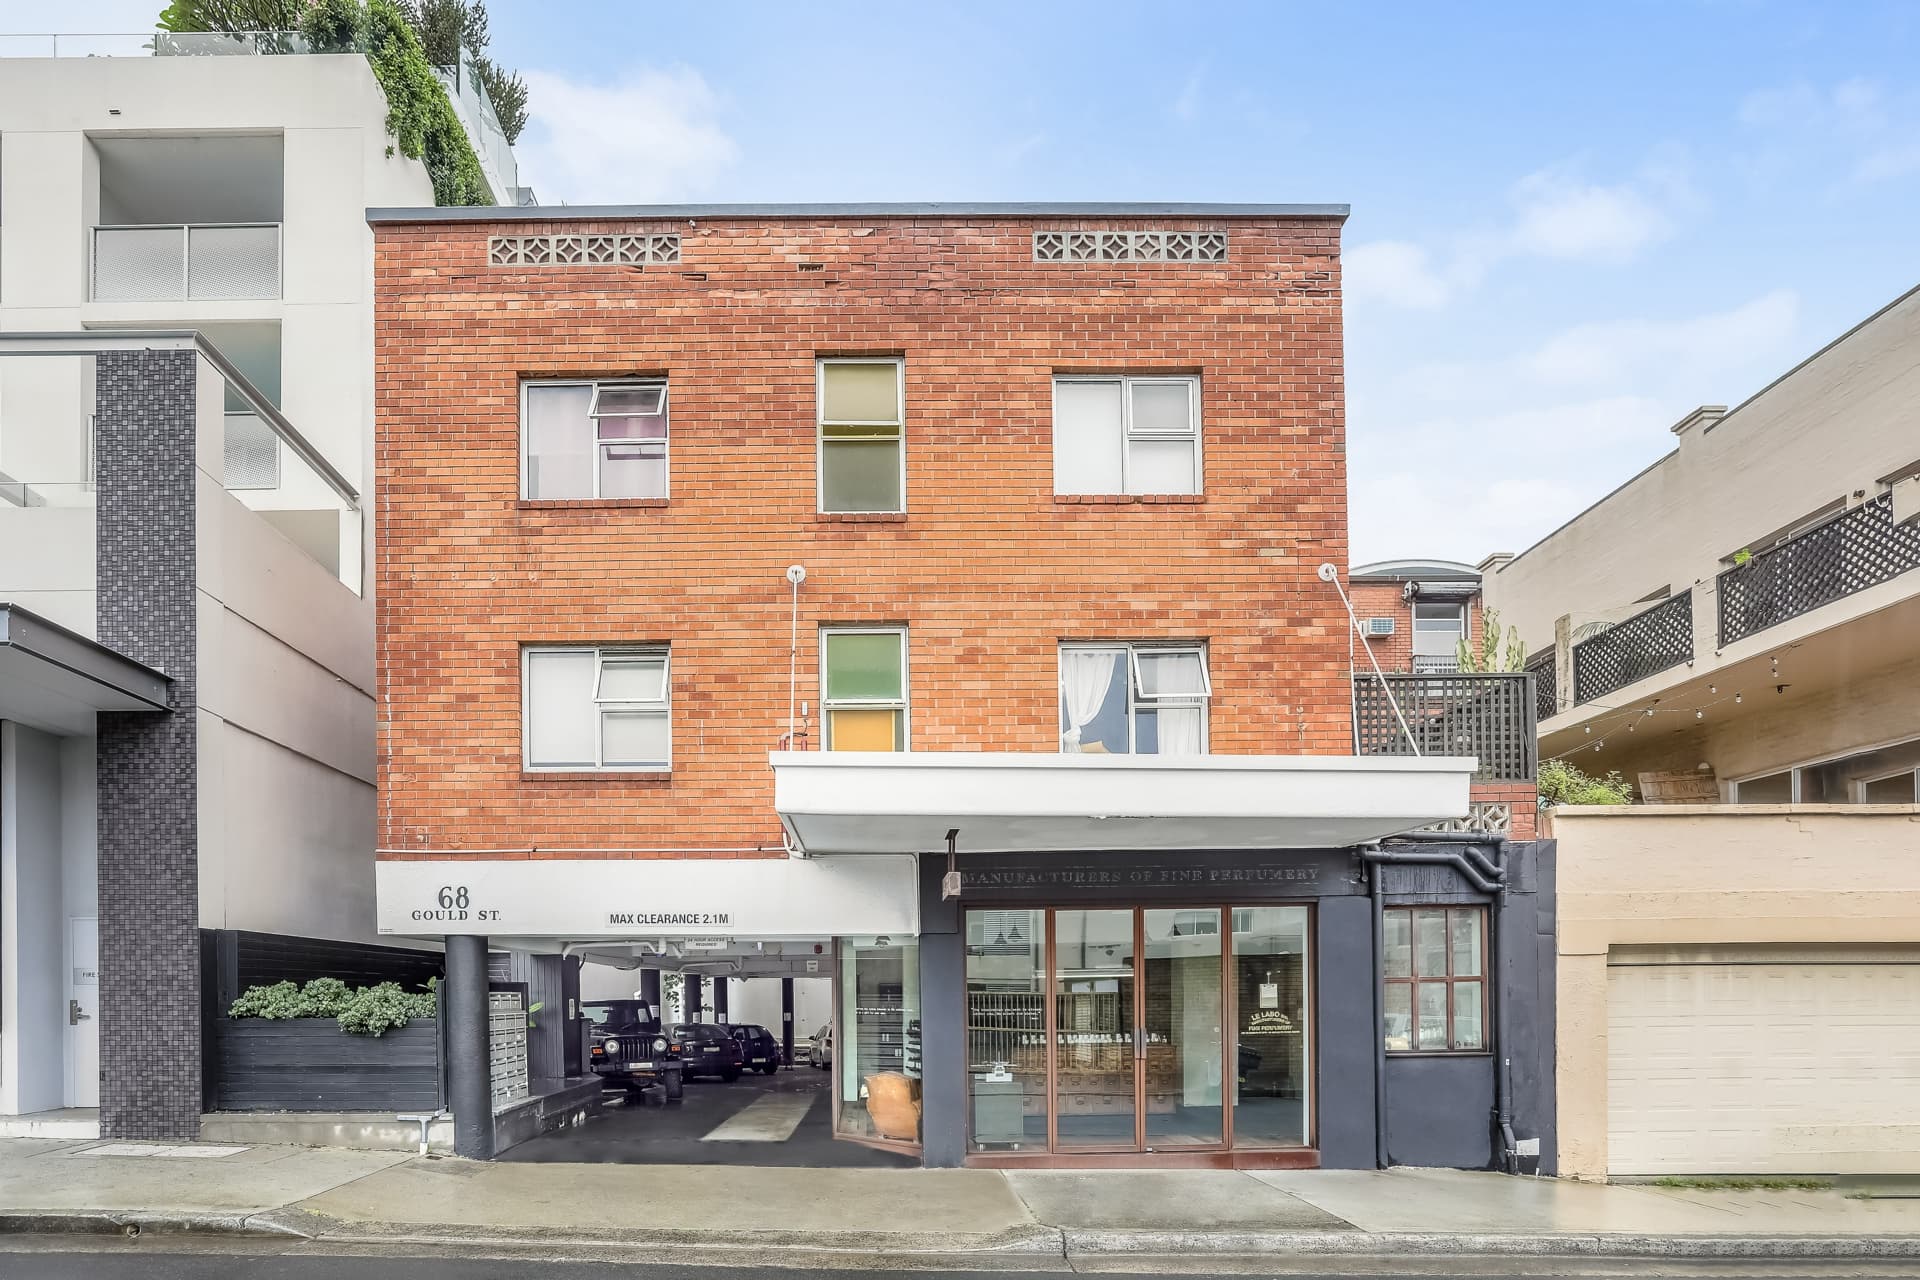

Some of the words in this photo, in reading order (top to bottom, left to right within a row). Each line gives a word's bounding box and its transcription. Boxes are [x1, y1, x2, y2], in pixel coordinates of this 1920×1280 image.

[961, 871, 1121, 884] MANUFACTURERS
[1130, 871, 1153, 882] OF
[1160, 870, 1202, 881] FINE
[1209, 868, 1321, 881] PERFUMERY
[438, 886, 470, 909] 68
[411, 910, 468, 921] GOULD
[478, 910, 502, 921] ST.
[610, 913, 634, 924] MAX
[637, 913, 700, 924] CLEARANCE
[703, 913, 729, 924] 2.1M
[1251, 1013, 1261, 1021] LE
